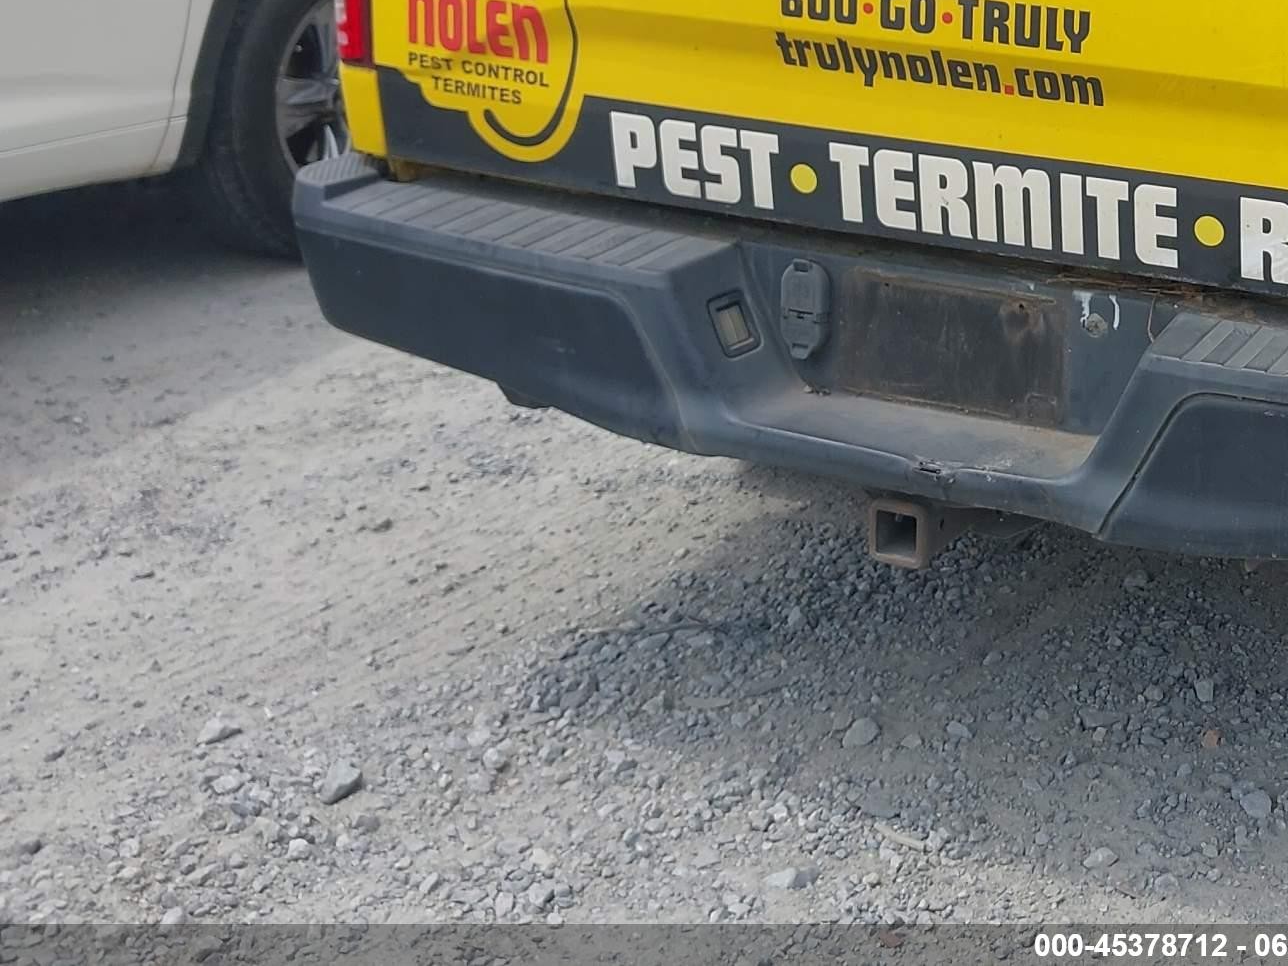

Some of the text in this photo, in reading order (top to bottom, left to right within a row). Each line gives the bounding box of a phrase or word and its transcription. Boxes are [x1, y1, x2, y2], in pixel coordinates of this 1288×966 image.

[408, 51, 549, 88] PEST CONTROL
[431, 75, 523, 106] TERMITES
[775, 30, 1105, 106] trulynolen.com
[610, 110, 780, 211] PEST
[829, 141, 1178, 269] TERMITE
